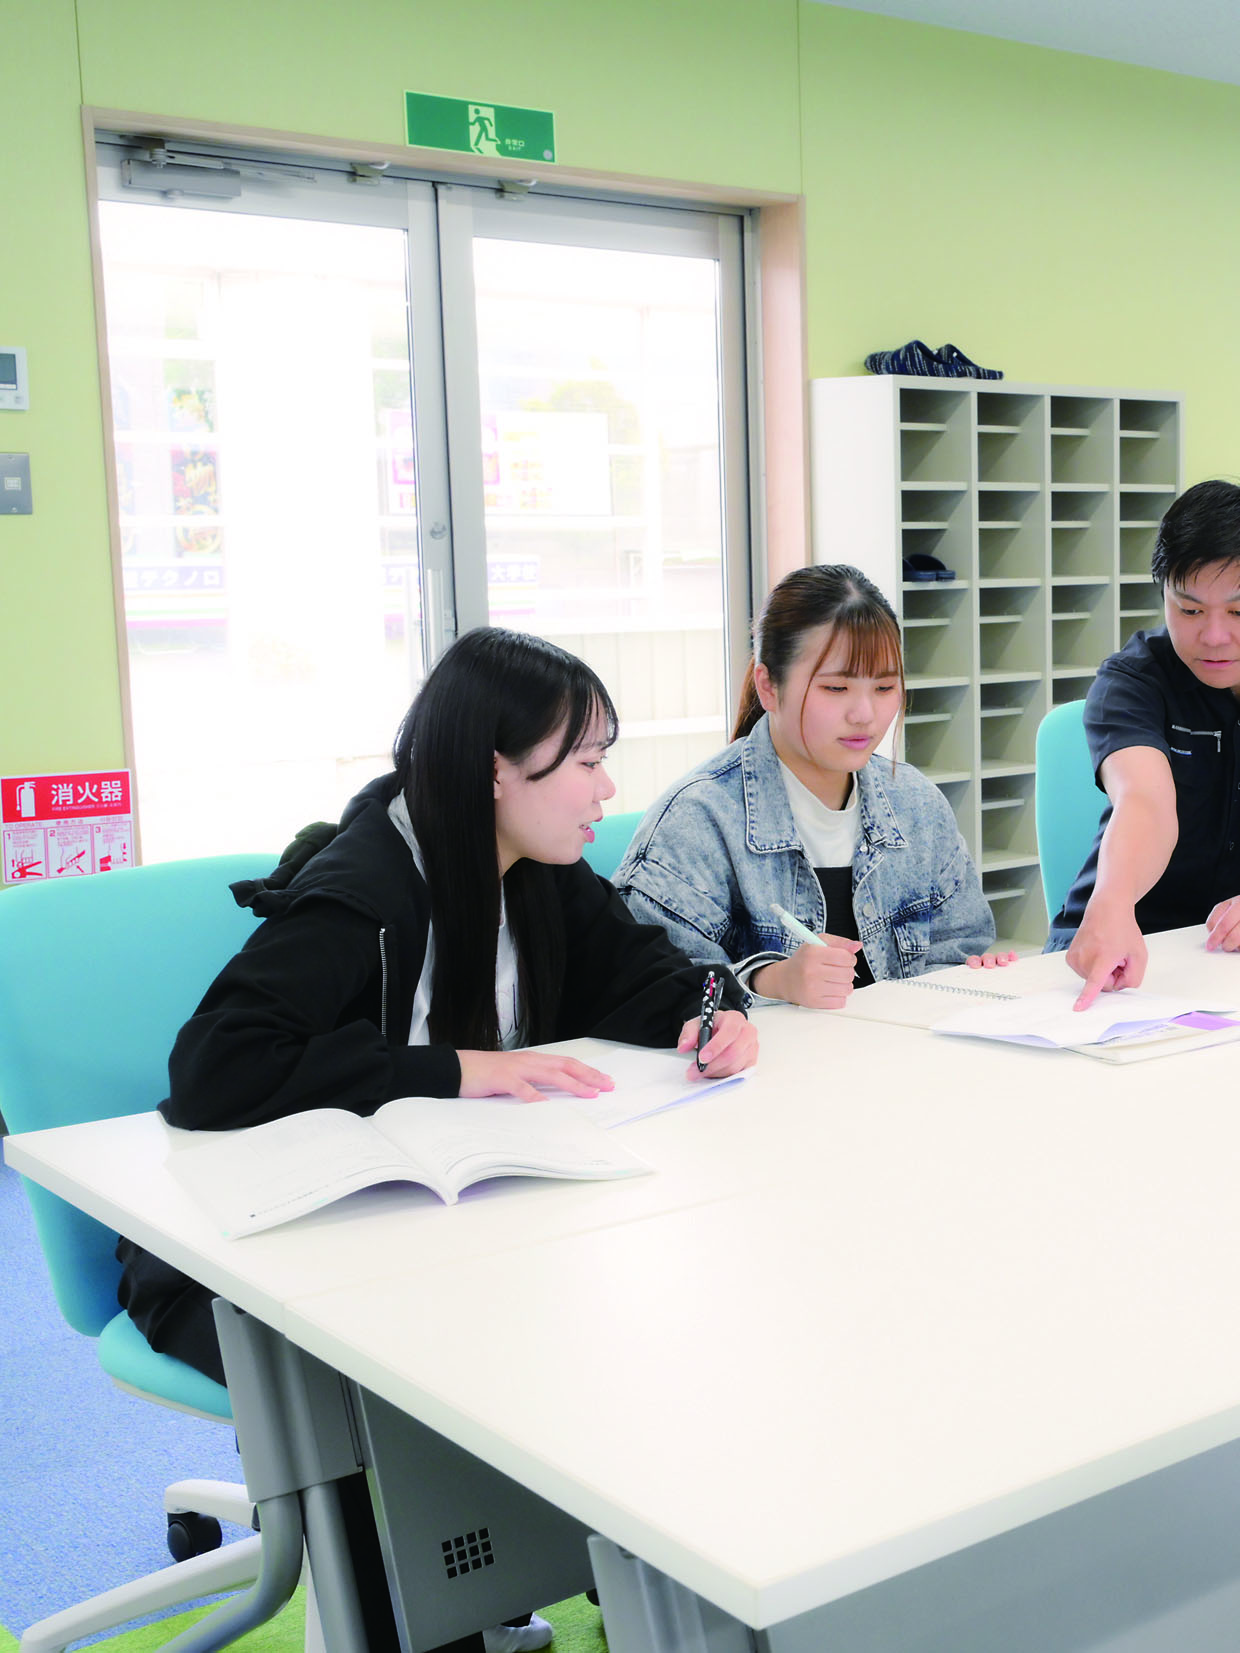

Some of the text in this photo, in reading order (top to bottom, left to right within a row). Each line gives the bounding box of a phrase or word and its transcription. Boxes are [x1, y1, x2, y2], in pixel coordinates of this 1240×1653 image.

[51, 781, 122, 805] 消火器
[95, 826, 101, 834] 3
